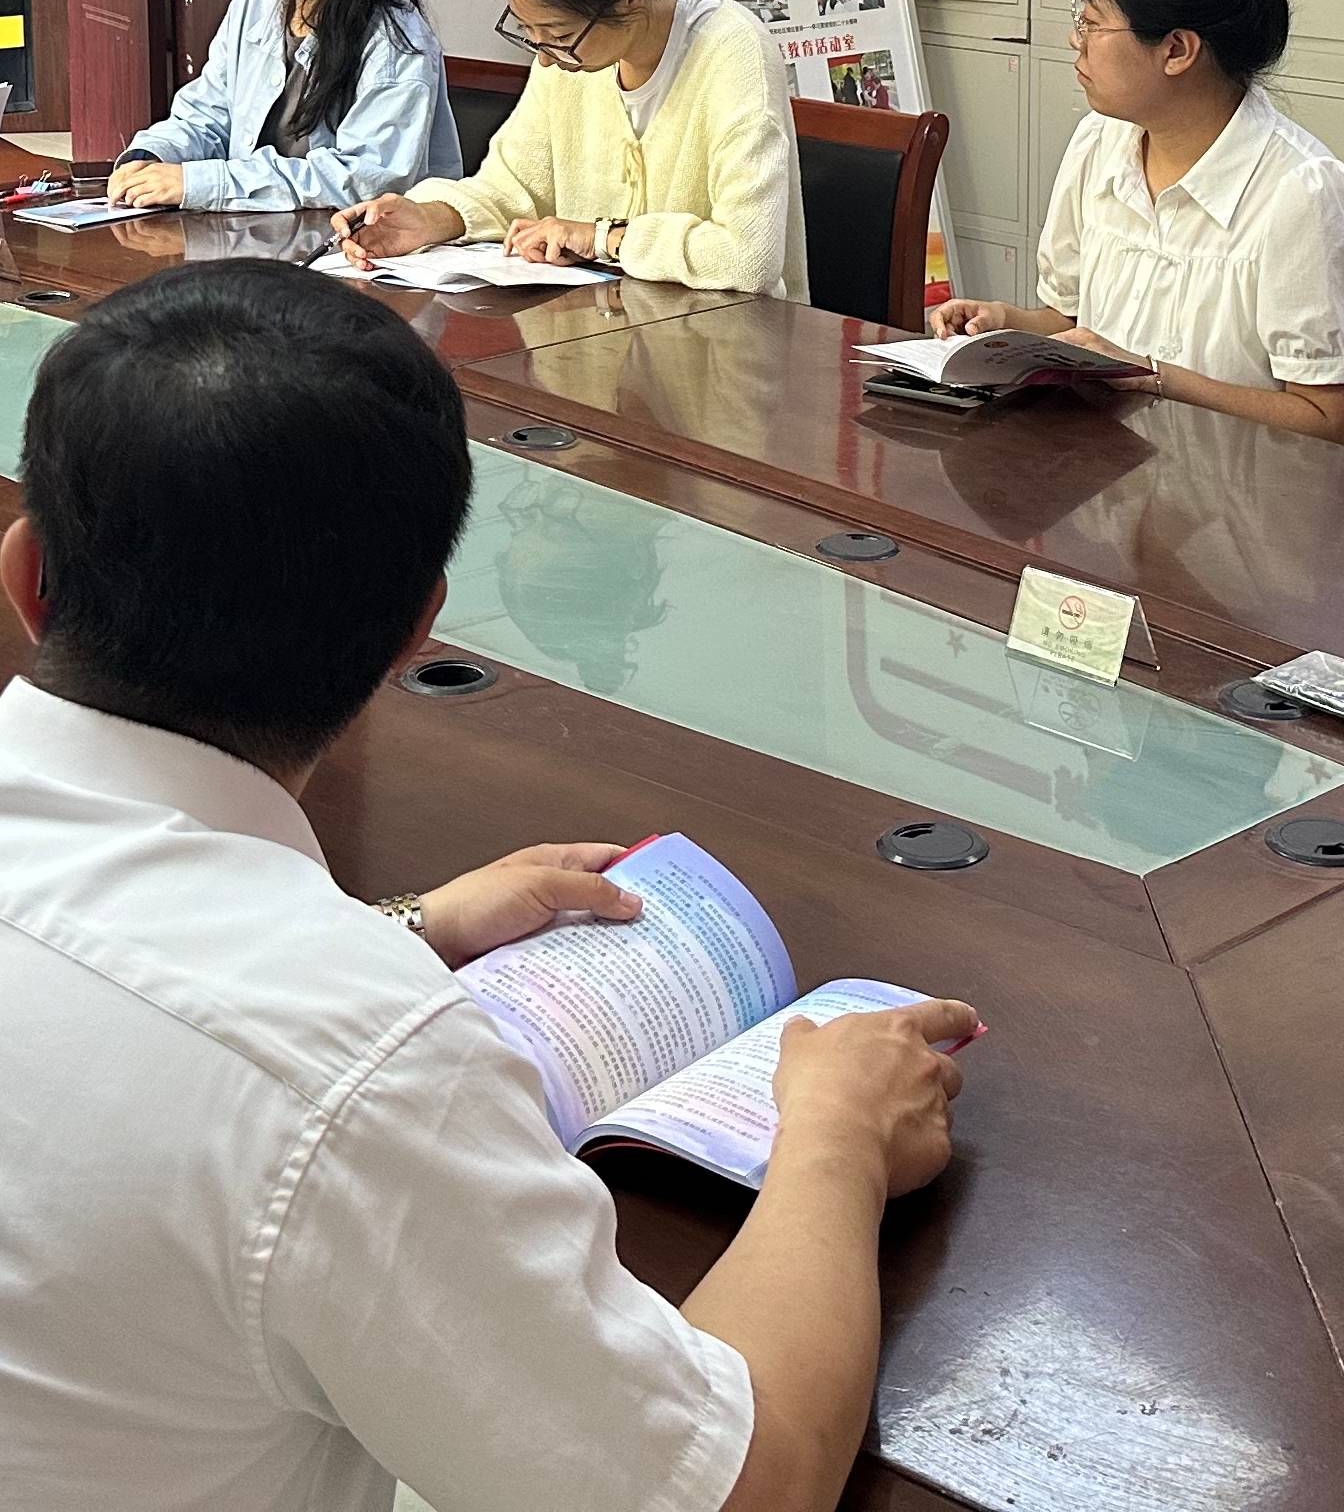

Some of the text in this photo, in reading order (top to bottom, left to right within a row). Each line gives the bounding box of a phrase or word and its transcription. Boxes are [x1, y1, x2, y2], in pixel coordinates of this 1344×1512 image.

[778, 34, 856, 60] 教育活动室
